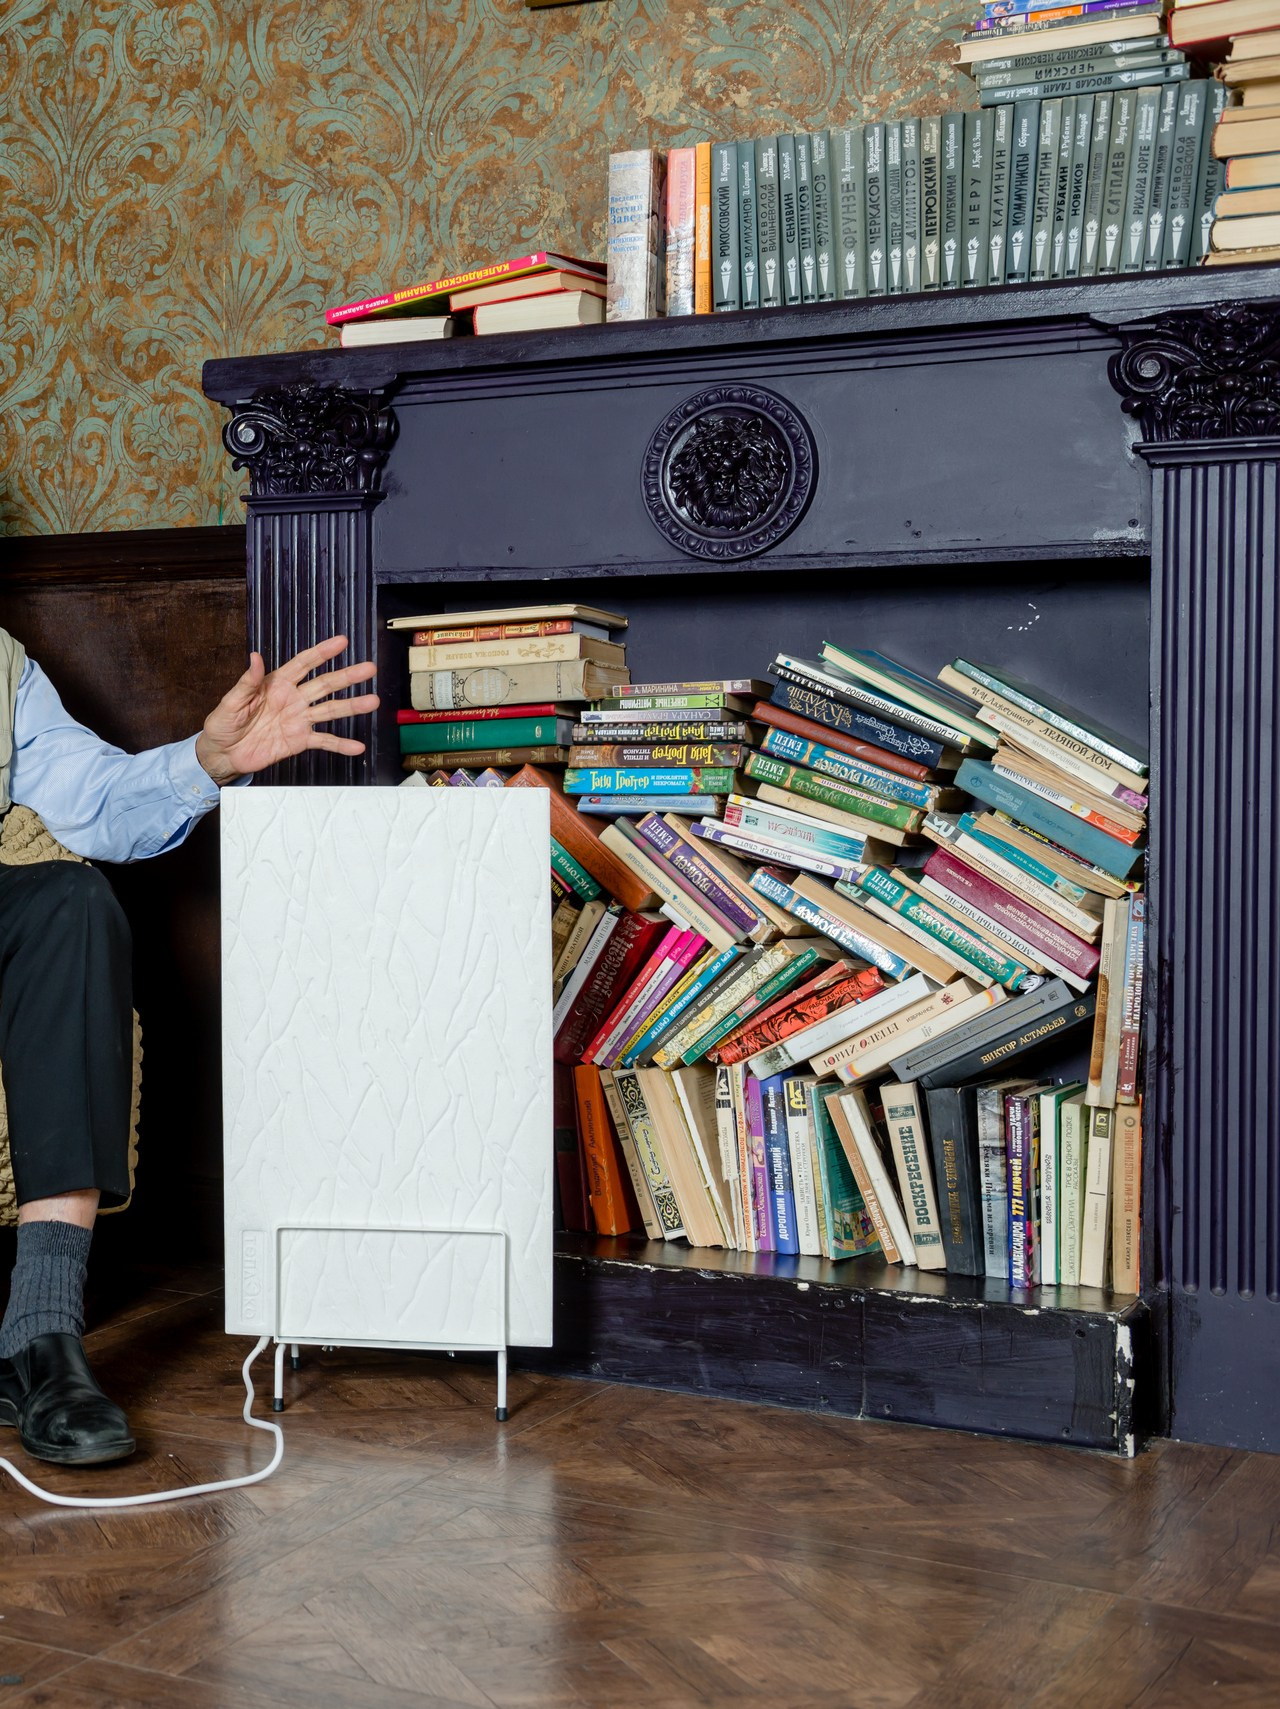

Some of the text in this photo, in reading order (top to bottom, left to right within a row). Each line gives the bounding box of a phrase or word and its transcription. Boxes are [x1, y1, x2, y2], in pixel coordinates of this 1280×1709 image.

[1013, 43, 1106, 68] АЛЕКСАНДР НЕВСКИЙ
[1033, 61, 1095, 81] ЧЕРСКИЙ
[1042, 75, 1114, 94] ЯРОСЛАВ ГАЛАН
[1018, 118, 1030, 147] Сборник
[924, 156, 938, 237] ПЕТРОВСКИЙ
[992, 149, 1006, 227] КАЛИНИН
[1012, 152, 1029, 226] КОММУНИСТЫ
[1036, 152, 1052, 223] ЧАПЛЫГИН
[1056, 166, 1068, 222] РУБАКИН
[1071, 162, 1084, 217] НОВИКОВ
[1106, 151, 1125, 216] САТПАЕВ
[1132, 145, 1150, 216] РИХАРД ЗОРГЕ
[1170, 136, 1187, 209] ВСЕВОЛОД
[1181, 136, 1196, 209] ВИШНЕВСКИЙ
[719, 185, 730, 258] РОКОССОВСКИЙ
[768, 183, 776, 252] ВИШНЕВСКИЙ
[786, 192, 795, 244] СЕНЯВИН
[799, 185, 812, 250] ШИШКОВ
[814, 174, 828, 248] ФУРМАНОВ
[841, 182, 857, 250] ФРУНЗЕ
[868, 176, 881, 244] ЧЕРКАСОВ
[904, 159, 917, 240] ДИМИТРОВ
[946, 174, 956, 233] ГОЛУБКИНА
[968, 178, 982, 226] НЕРУ
[331, 262, 510, 318] КАЛЕЙДОСКОП ЗНАНИЙ ДАЙДЖЕСТ
[619, 697, 687, 709] СЕКРЕТНЫЕ МАТЕРИАЛЫ
[641, 684, 678, 694] МАРИНИНА
[671, 710, 711, 719] САНДРА
[756, 757, 785, 775] ЕМЕЦ
[774, 732, 803, 751] ЕМЕЦ
[1038, 723, 1112, 771] ЛЕДЯНОЙ ДОМ
[647, 818, 674, 845] ЕМЕЦ
[557, 855, 590, 890] ИСТОРИЯ
[670, 852, 713, 893] БУСЛАЕВ
[870, 870, 900, 896] ЕМЕЦ
[566, 926, 584, 954] БЛАТНОЙ
[583, 934, 603, 965] МАЛЬЧИК
[602, 916, 613, 931] ТЬМА
[974, 913, 1010, 940] СОБАЧЬИ
[1124, 925, 1137, 1028] ИСТОРИЯ ГОСУДАРСТВА
[1134, 940, 1143, 976] РОССИИ
[696, 990, 714, 1007] БЕСЕДЫ
[711, 985, 719, 993] ОБ
[807, 983, 856, 1011] РАБОЧАЯ ЧЕСТЬ
[1132, 980, 1141, 1021] НАРОДОВ
[822, 1043, 858, 1069] ЮРИЙ
[980, 1015, 1066, 1064] ВИКТОР АСТАФЬЕВ
[769, 1108, 777, 1134] Владимир
[586, 1099, 602, 1197] Владимир Амлинский
[942, 1139, 956, 1181] ГОРОДОК
[771, 1146, 788, 1240] ДОРОГАМИ ИСПЫТАНИЙ
[898, 1125, 931, 1226] ВОСКРЕСЕНИЕ
[982, 1143, 994, 1255] Земляки Письма из деревни
[1011, 1198, 1024, 1216] 777
